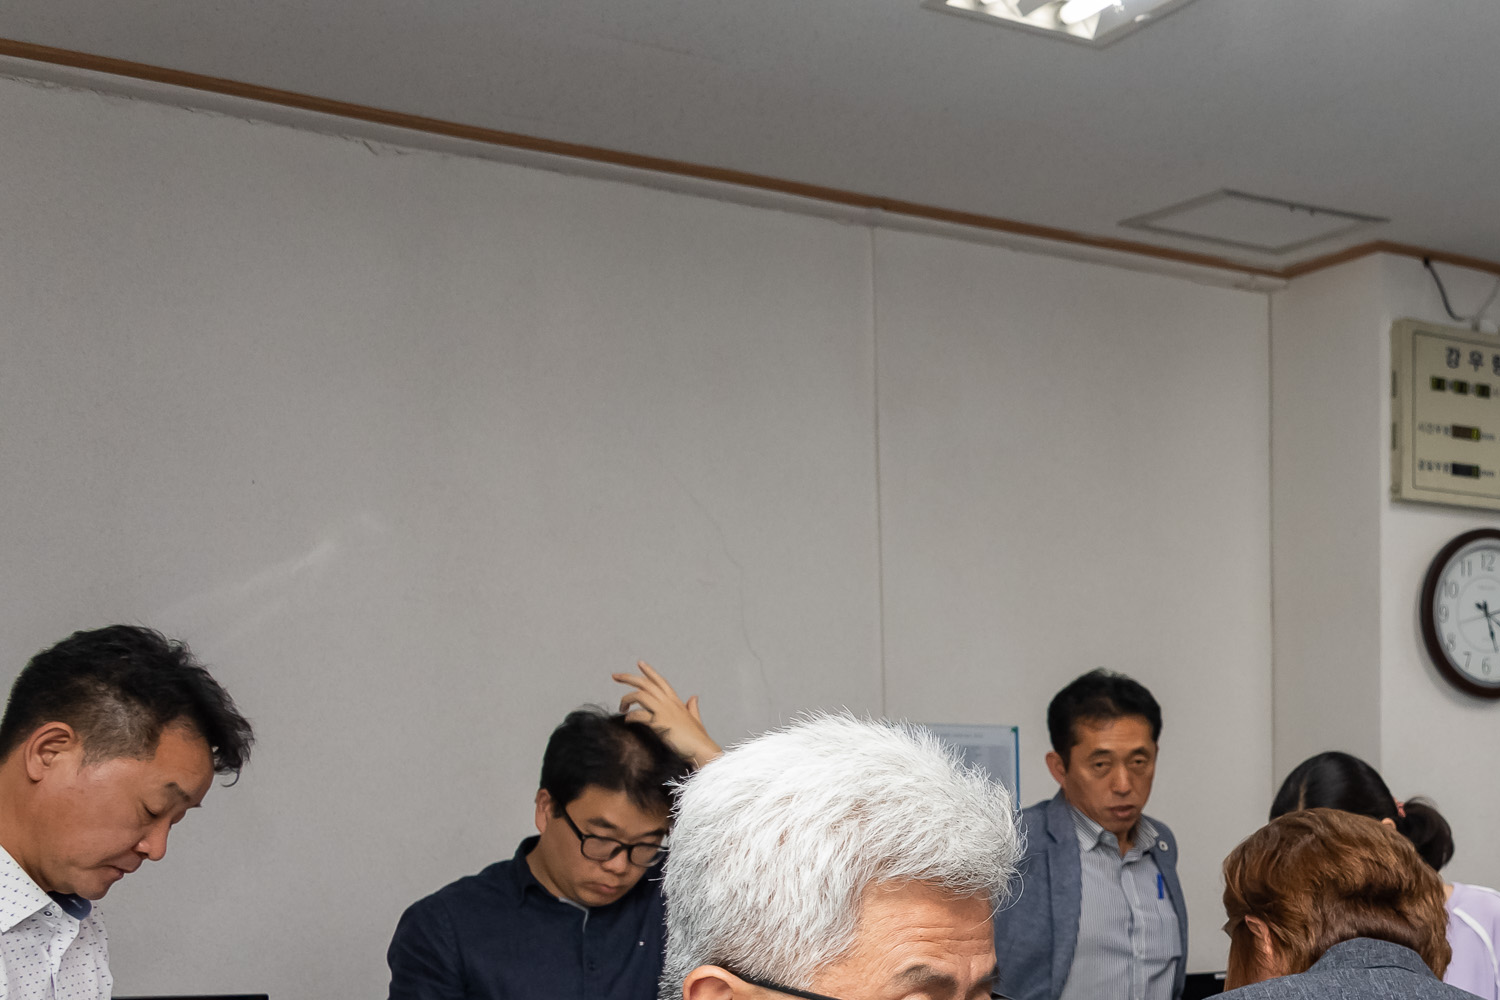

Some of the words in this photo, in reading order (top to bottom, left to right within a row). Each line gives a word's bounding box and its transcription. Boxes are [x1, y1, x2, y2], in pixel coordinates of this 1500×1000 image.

[1460, 560, 1472, 577] 11
[1481, 553, 1495, 572] 12
[1444, 580, 1459, 599] 10
[1439, 605, 1449, 624] 9
[1463, 651, 1472, 668] 7
[1481, 657, 1491, 676] 6
